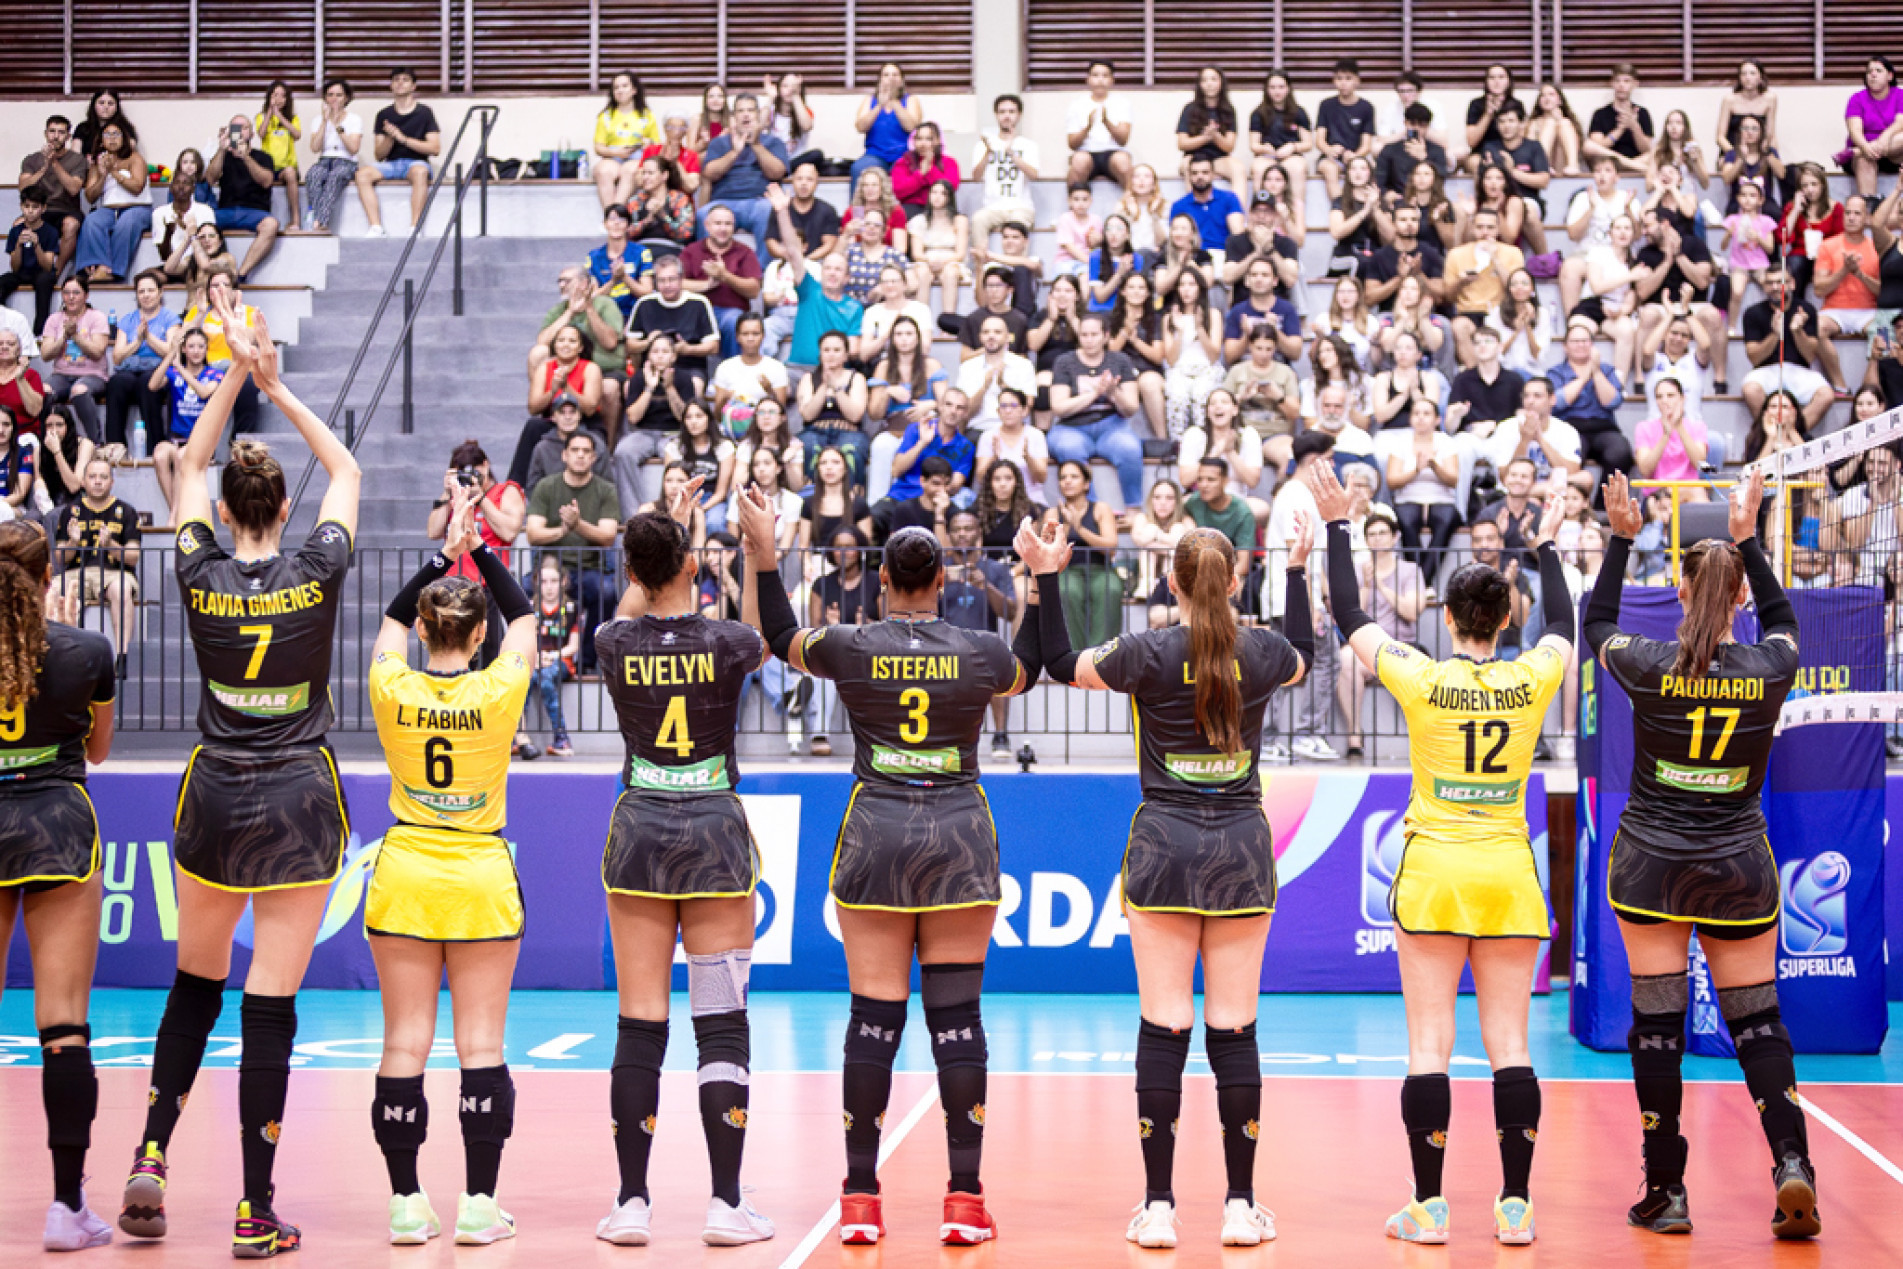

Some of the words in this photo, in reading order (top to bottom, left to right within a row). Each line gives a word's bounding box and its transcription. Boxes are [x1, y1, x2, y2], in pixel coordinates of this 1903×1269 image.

[997, 166, 1019, 181] DO
[248, 580, 324, 617] GIMENES
[239, 623, 273, 681] 7
[871, 655, 959, 679] ISTEFANI
[624, 652, 715, 687] EVELYN
[1428, 684, 1490, 712] AUDREN
[1493, 683, 1533, 711] ROSE
[397, 704, 411, 727] L.
[417, 707, 483, 731] FABIAN
[654, 695, 695, 757] 4
[899, 686, 930, 744] 3
[1458, 719, 1511, 774] 12
[1685, 705, 1741, 760] 17
[425, 735, 454, 788] 6
[635, 766, 710, 785] HELIAR
[1171, 759, 1237, 773] HELIAR
[1779, 956, 1857, 979] SUPERLIGA
[383, 1105, 417, 1122] N1
